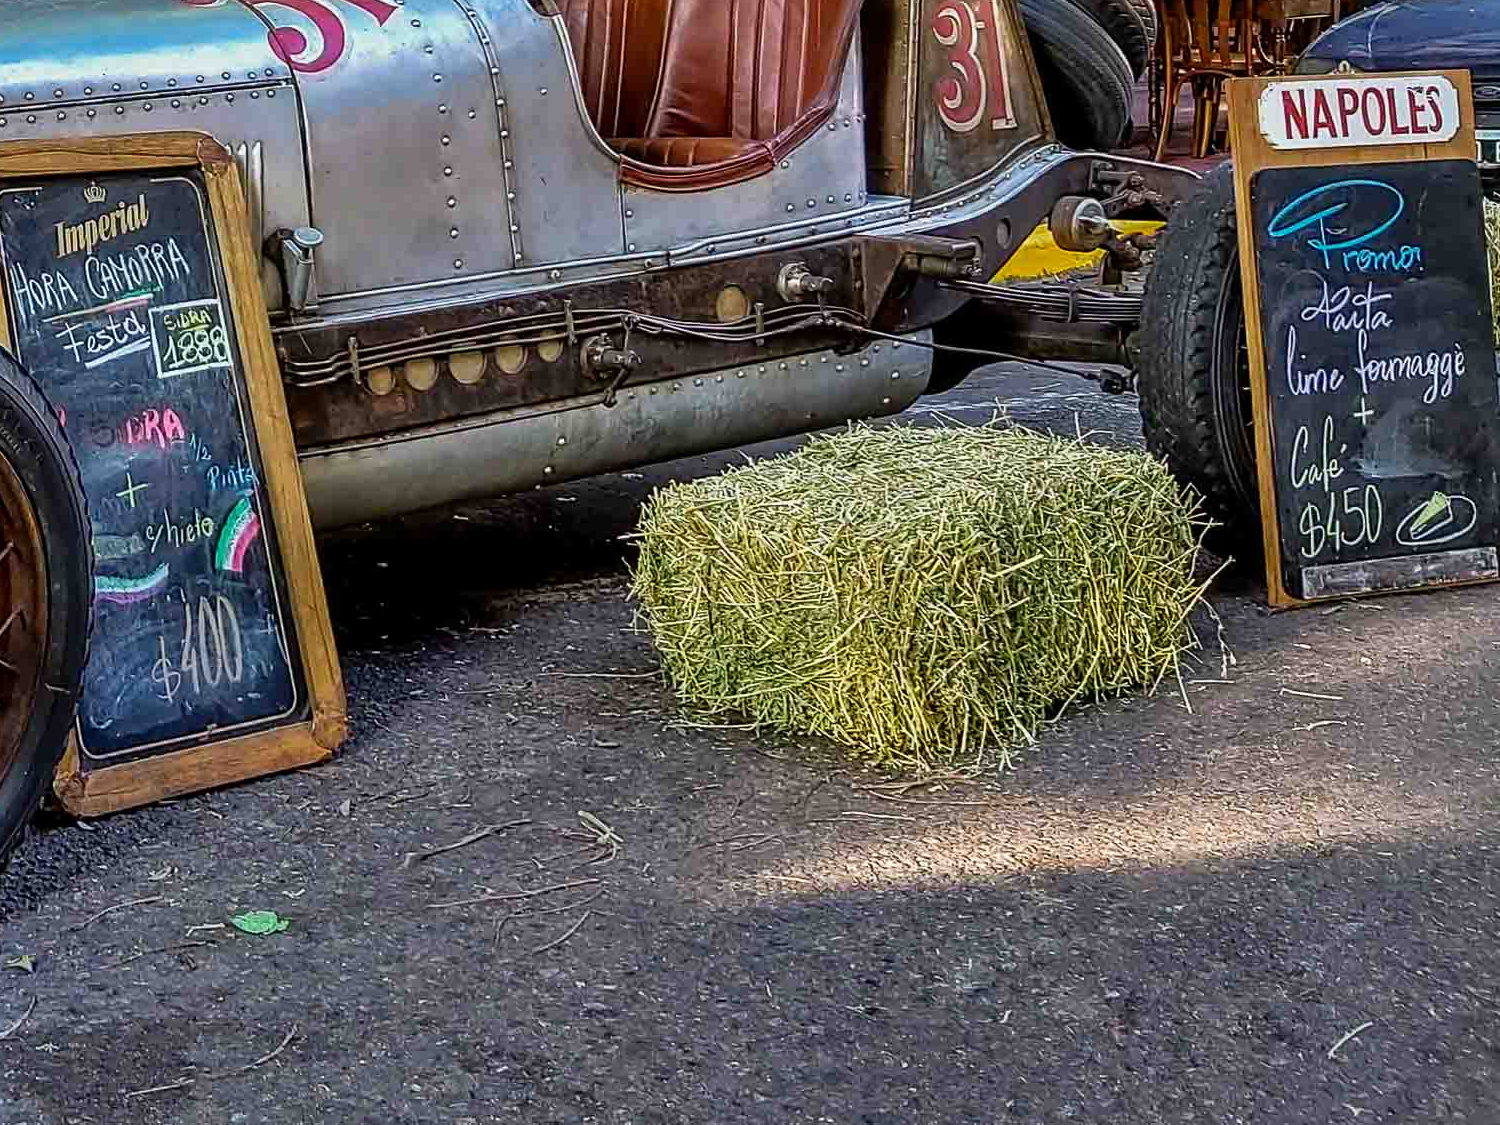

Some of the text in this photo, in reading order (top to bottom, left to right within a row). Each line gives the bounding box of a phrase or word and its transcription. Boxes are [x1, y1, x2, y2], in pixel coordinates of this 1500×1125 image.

[1281, 85, 1444, 141] NAPOLES
[53, 194, 150, 259] Imperial
[10, 261, 78, 322] HORA
[55, 310, 147, 363] Festa
[162, 326, 229, 369] 1888
[1291, 415, 1348, 493] Café
[1299, 484, 1383, 559] $450
[152, 594, 243, 703] $400
